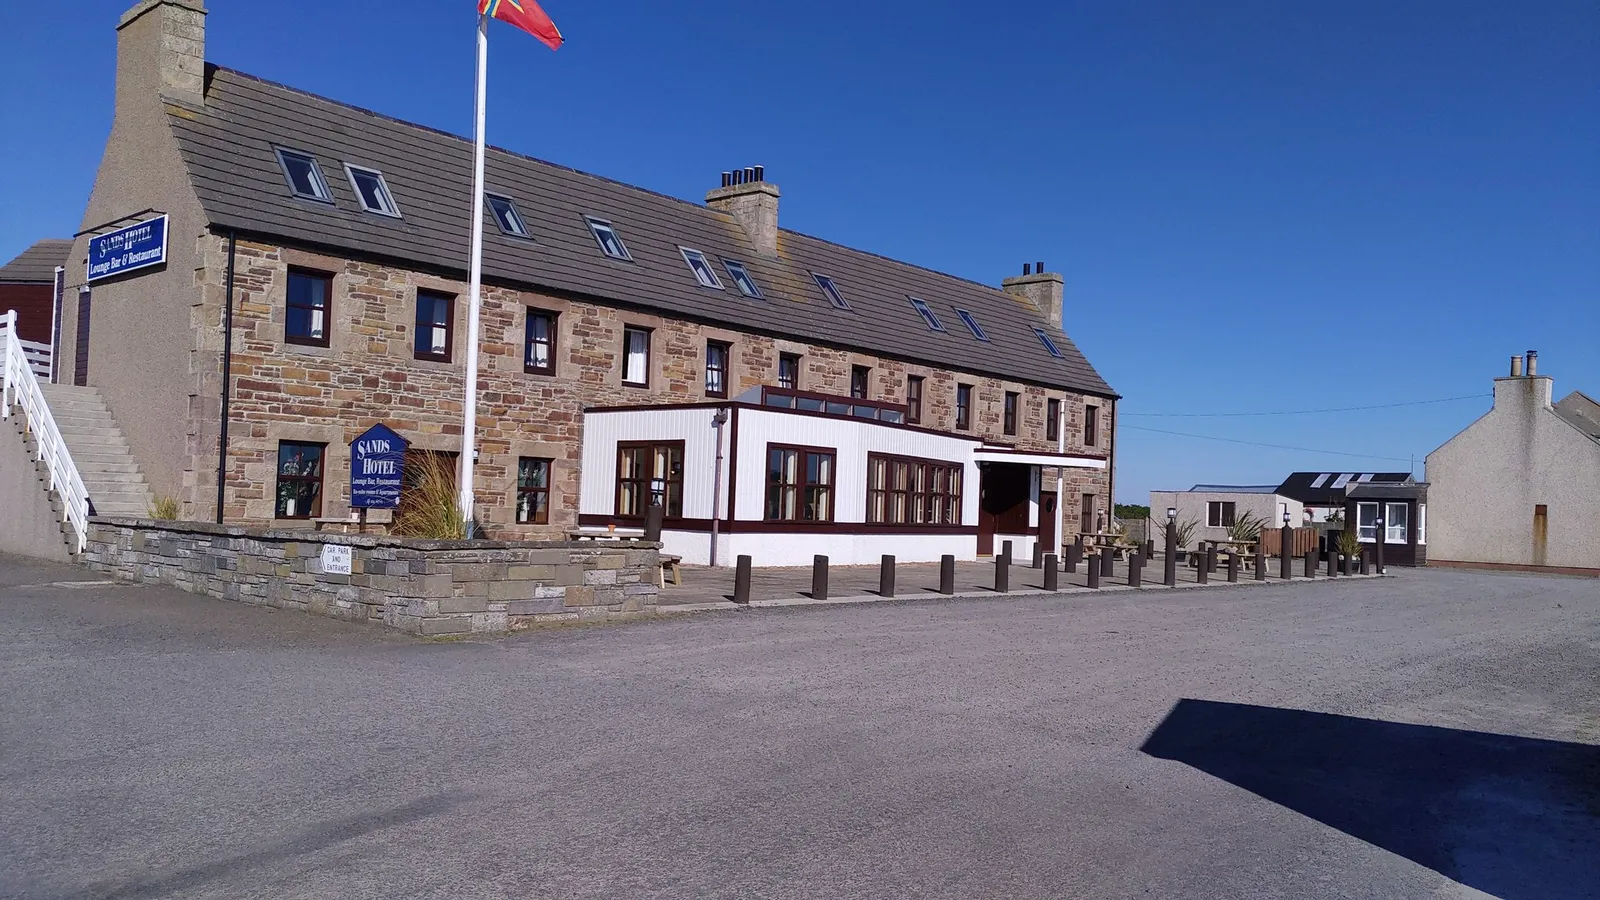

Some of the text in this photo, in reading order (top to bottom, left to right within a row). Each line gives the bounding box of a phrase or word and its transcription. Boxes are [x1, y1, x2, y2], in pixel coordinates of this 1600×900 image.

[90, 246, 161, 274] Lounge Bar & Restaurant
[353, 478, 367, 486] Lounge
[327, 564, 349, 572] ENTRANCE
